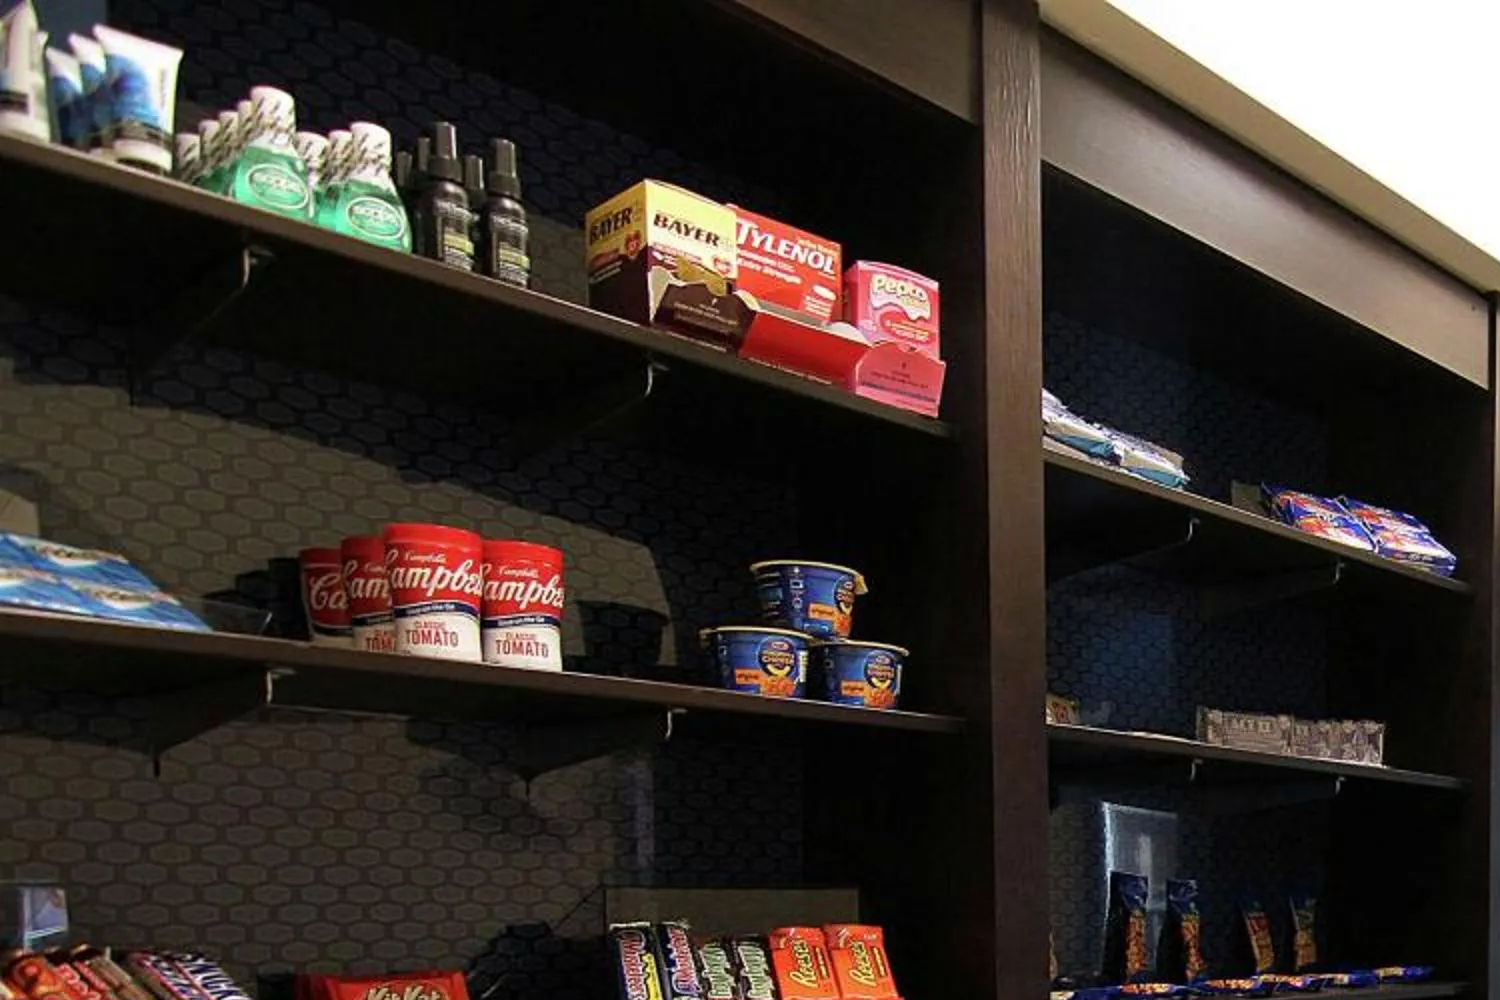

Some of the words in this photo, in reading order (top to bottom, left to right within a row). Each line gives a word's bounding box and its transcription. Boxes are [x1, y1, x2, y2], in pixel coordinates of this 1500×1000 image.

[653, 212, 720, 247] BAYER
[736, 217, 836, 276] TYLENOL
[405, 629, 458, 648] TOMATO
[495, 639, 549, 658] TOMATO
